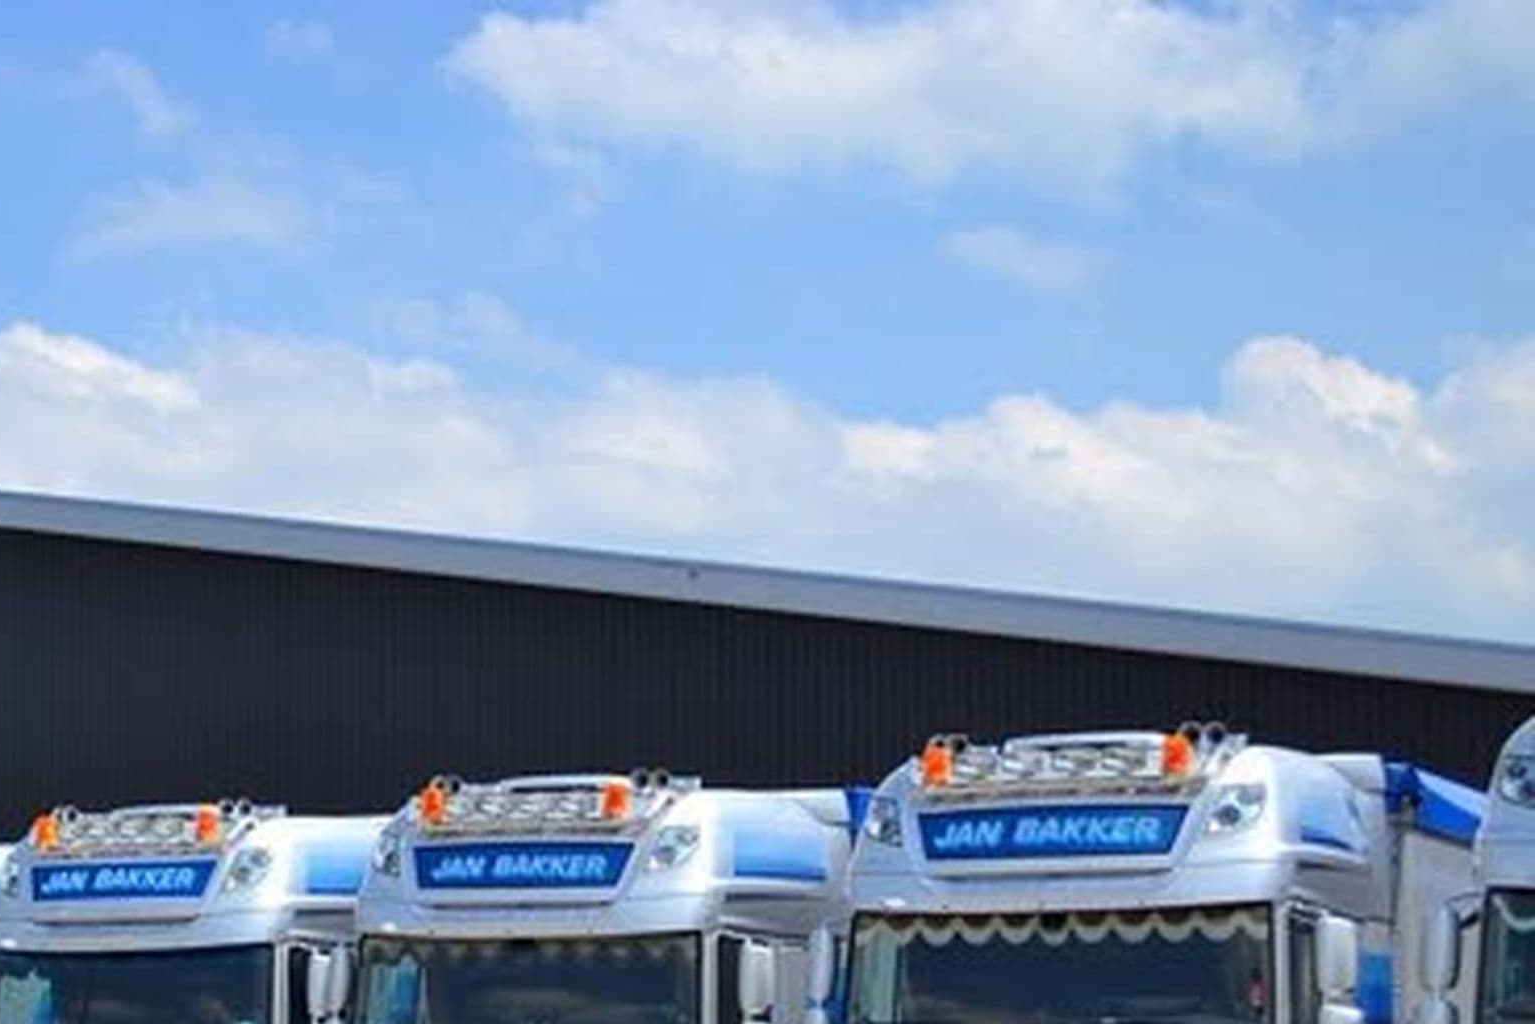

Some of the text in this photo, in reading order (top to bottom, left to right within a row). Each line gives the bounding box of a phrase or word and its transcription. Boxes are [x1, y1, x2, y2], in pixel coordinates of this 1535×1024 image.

[933, 815, 1160, 849] JAN BAKKER
[41, 866, 194, 893] JAN BAKKER
[430, 853, 607, 881] JAN BAKKER
